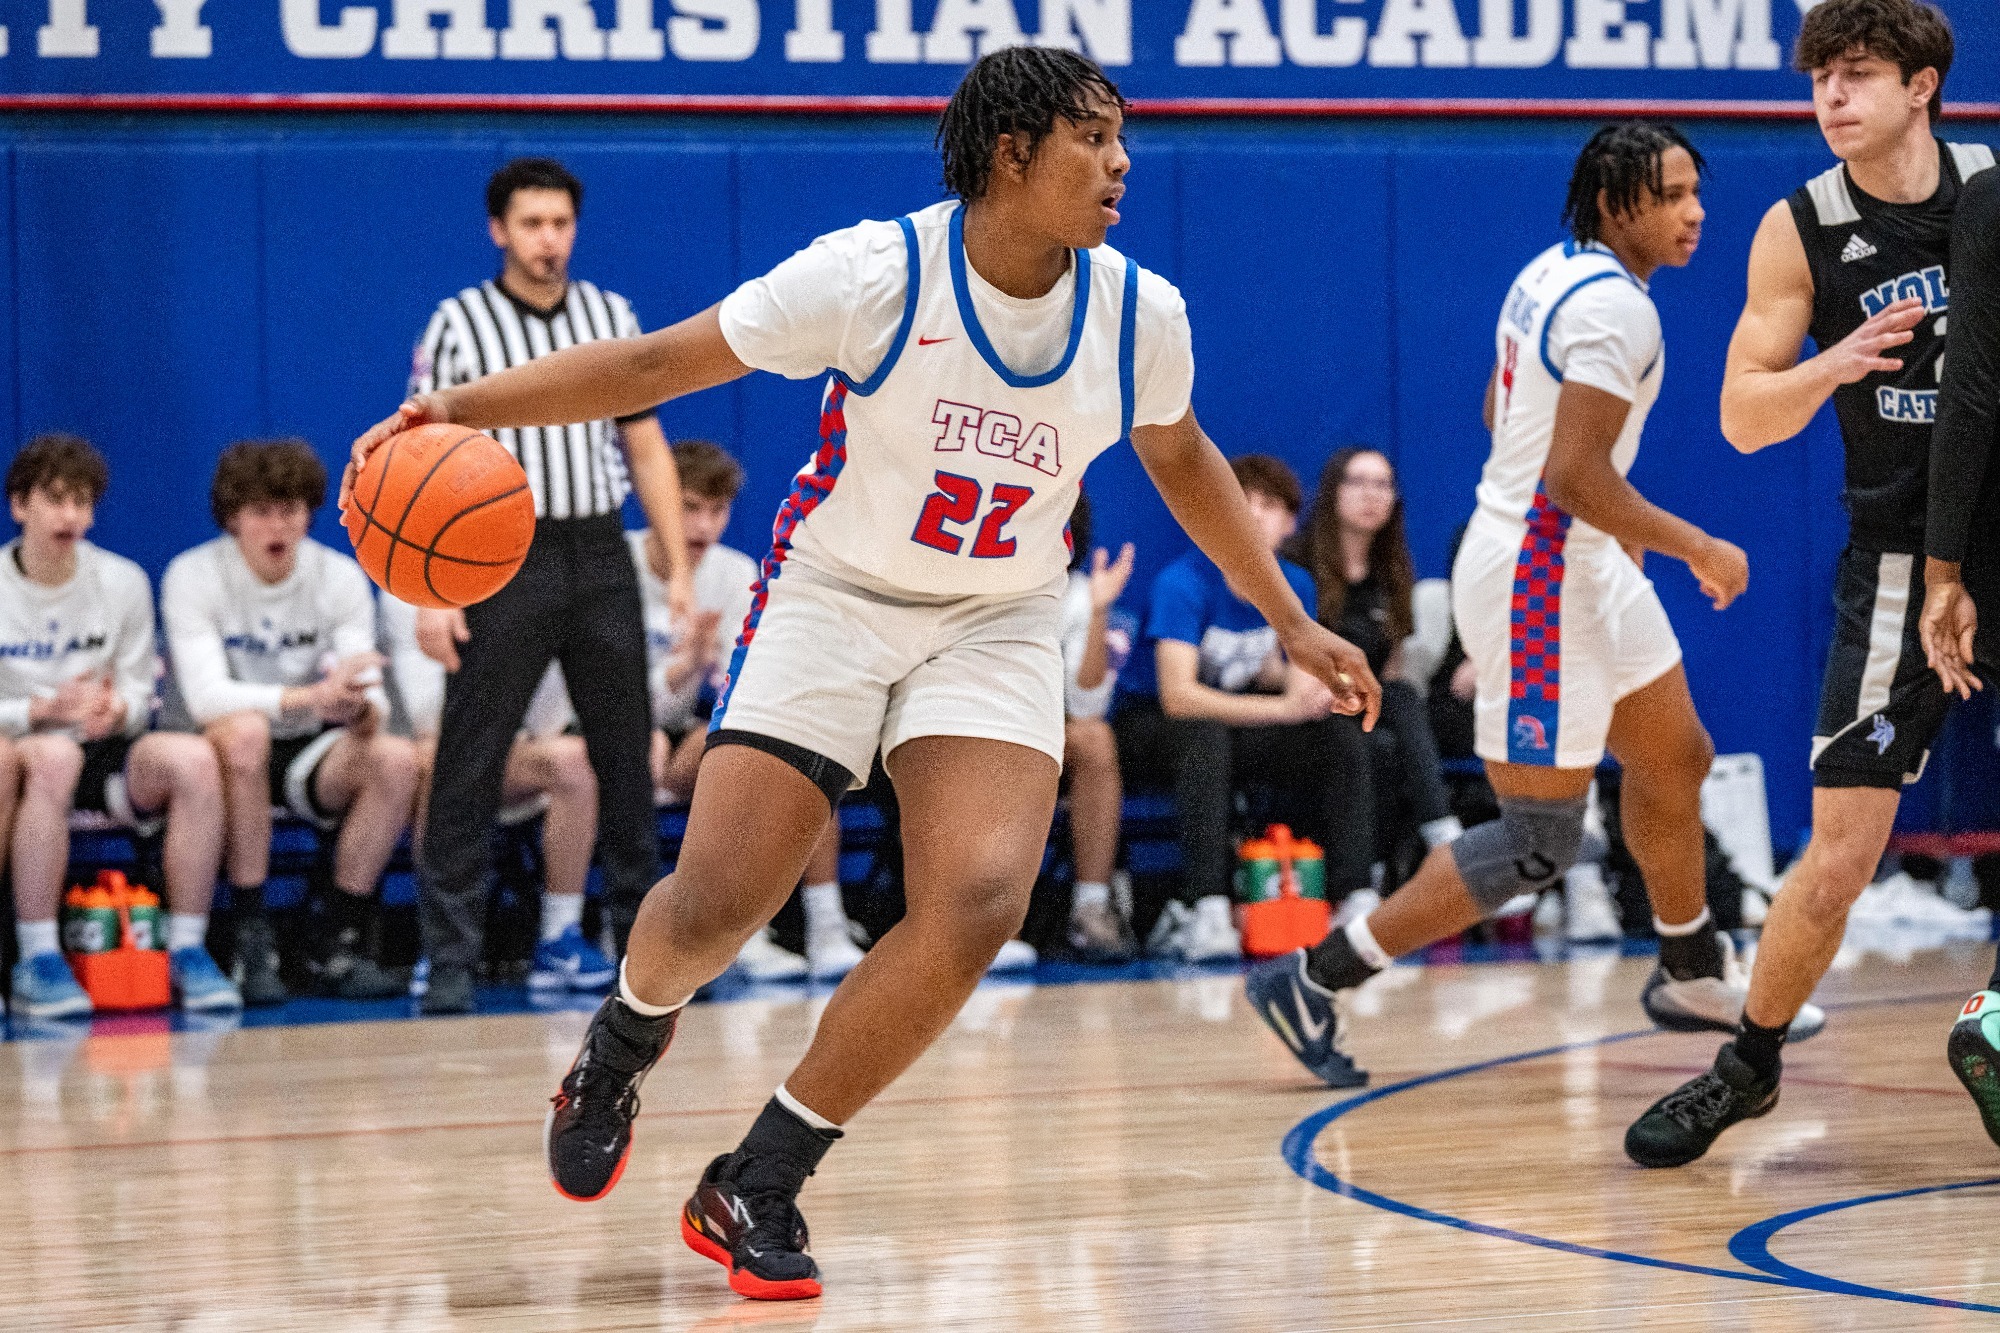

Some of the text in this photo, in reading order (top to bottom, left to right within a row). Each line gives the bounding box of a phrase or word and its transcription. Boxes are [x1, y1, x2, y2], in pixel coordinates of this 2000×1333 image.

[0, 0, 1826, 70] TY CHRISTIAN ACADEM
[1841, 244, 1878, 263] adidas
[932, 398, 1063, 478] TCA
[910, 469, 1035, 559] 22
